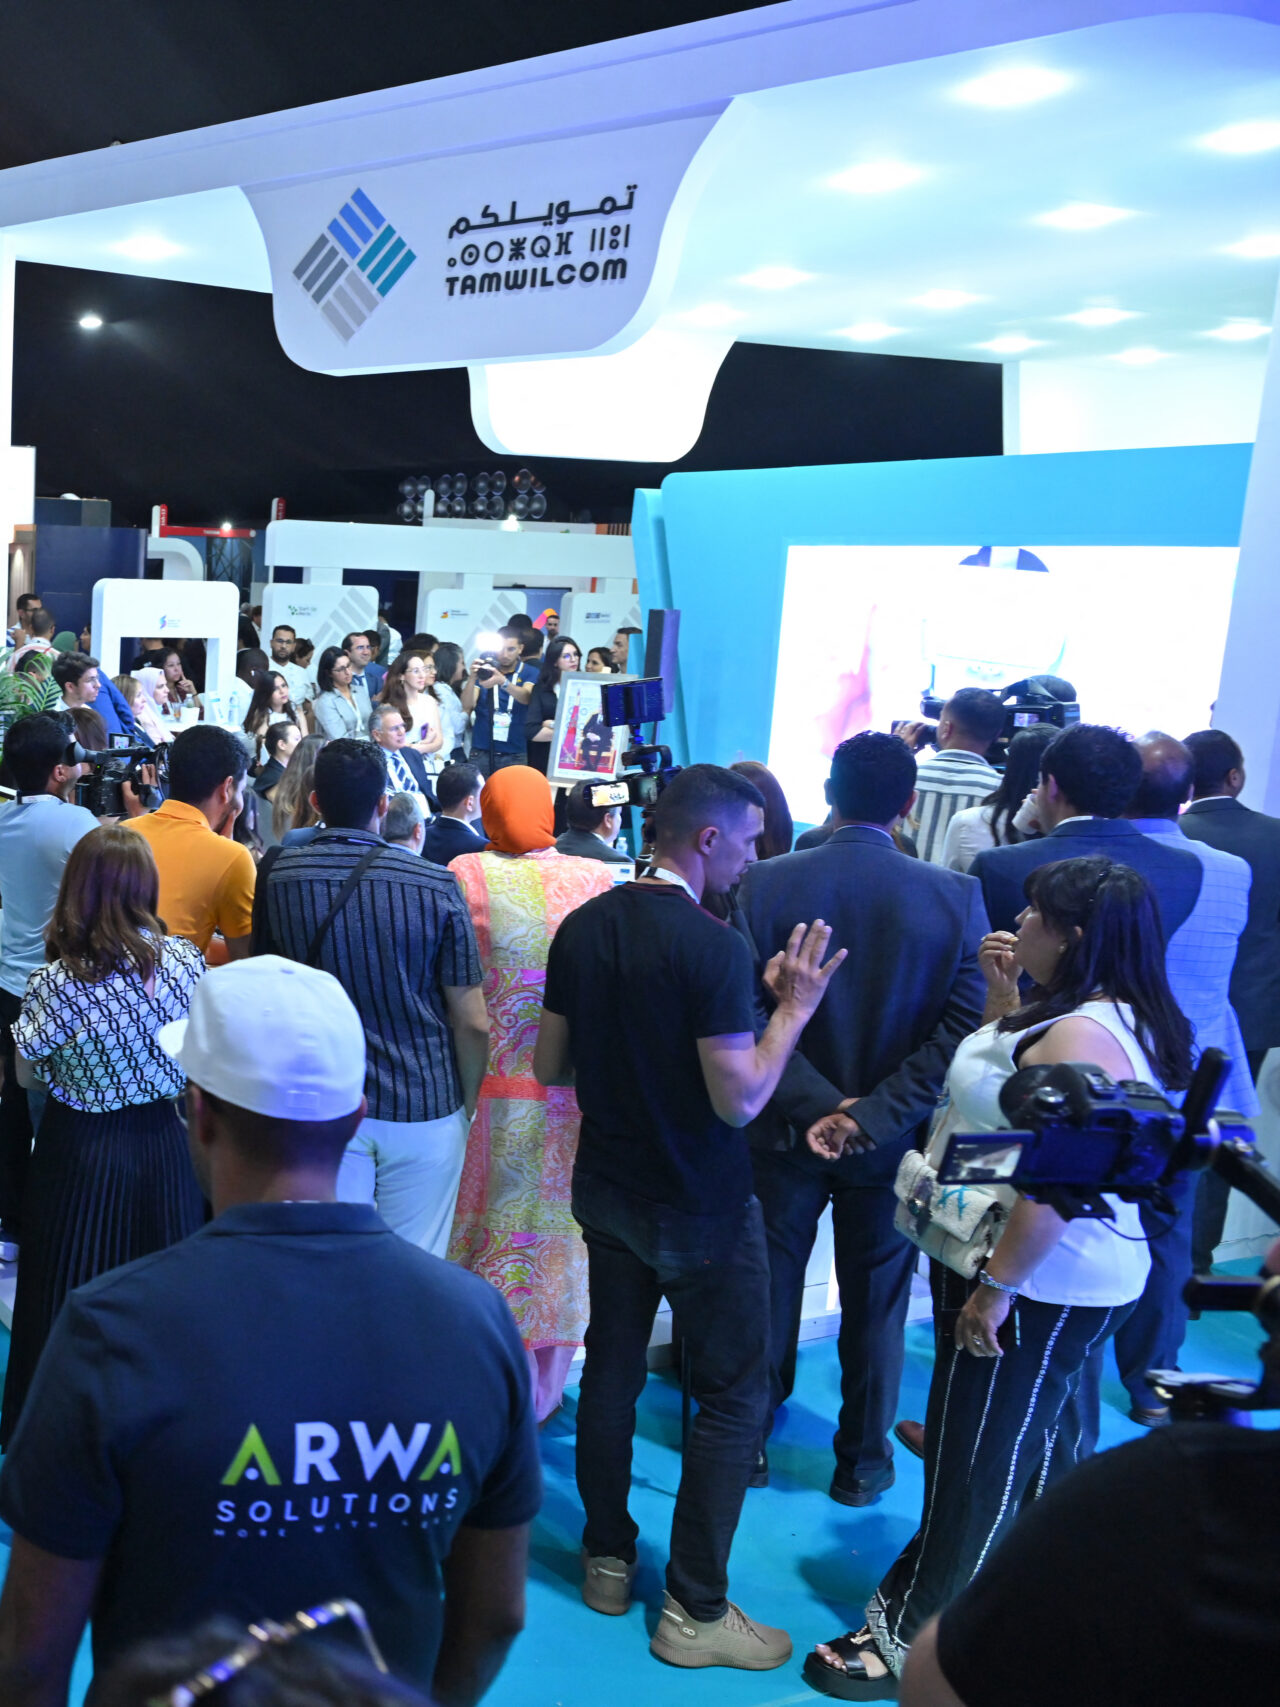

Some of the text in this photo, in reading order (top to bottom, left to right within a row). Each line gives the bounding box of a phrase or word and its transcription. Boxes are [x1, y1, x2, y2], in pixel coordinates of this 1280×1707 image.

[445, 257, 628, 297] TAMWILCOM
[220, 1420, 462, 1486] ARWA
[216, 1487, 458, 1523] SOLUTIONS
